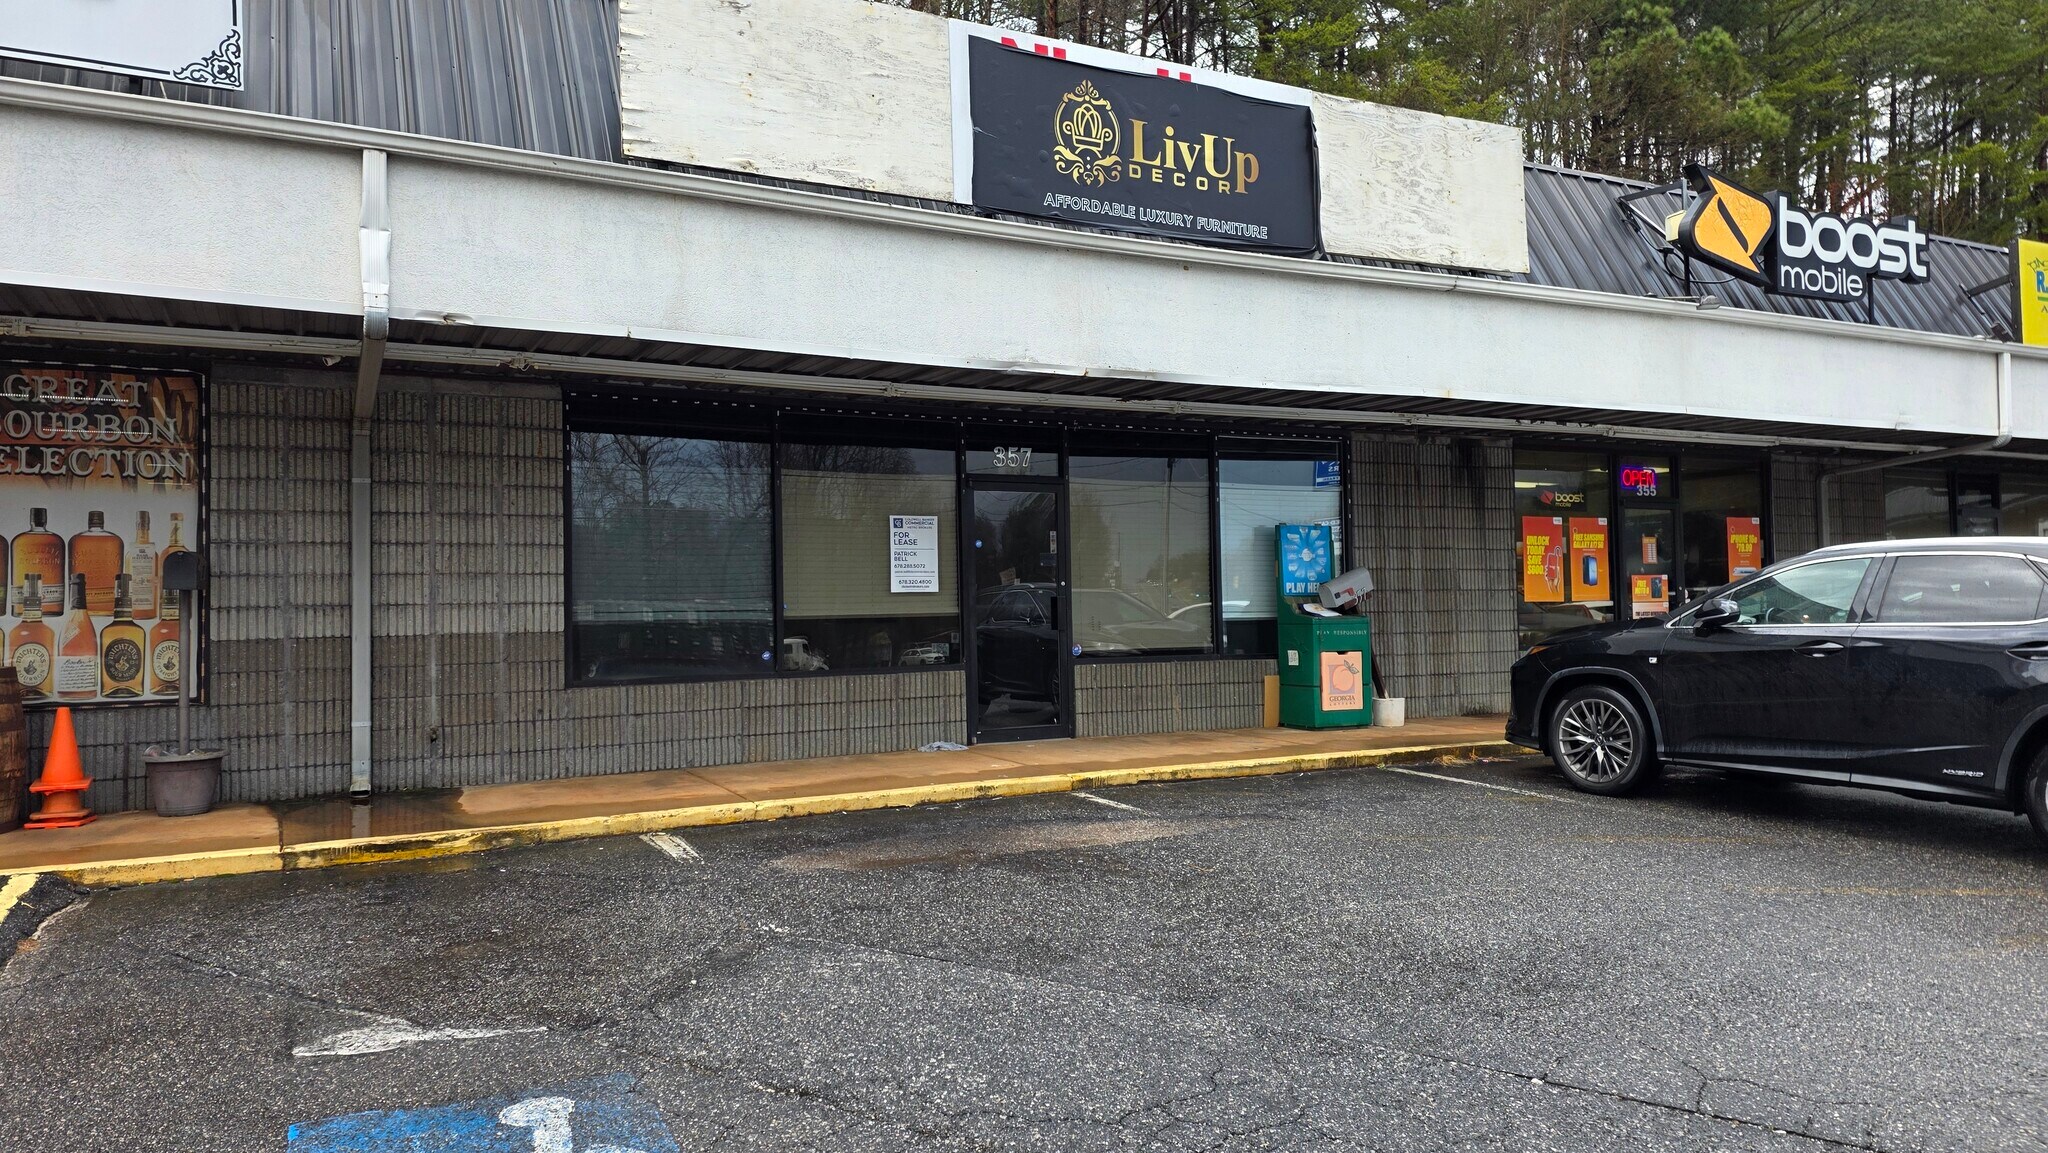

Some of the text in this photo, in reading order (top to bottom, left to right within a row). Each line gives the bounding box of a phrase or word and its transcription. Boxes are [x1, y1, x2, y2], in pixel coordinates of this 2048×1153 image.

[1129, 118, 1260, 194] LivUp
[1129, 164, 1231, 194] DECOR
[1043, 192, 1268, 240] AFFORDABLE LUXURY FURNITURE
[1778, 195, 1927, 278] boost
[1780, 264, 1863, 297] mobile
[3, 374, 148, 408] GREAT
[0, 410, 177, 445] OURBON
[993, 446, 1033, 467] 357
[1622, 469, 1655, 486] OPEN
[1554, 491, 1584, 503] boost
[1636, 485, 1657, 496] 355
[1526, 535, 1550, 546] UNLOCK
[1527, 555, 1542, 565] SAVE
[1286, 582, 1320, 593] PLAY HE
[1942, 768, 1984, 777] HYBRID
